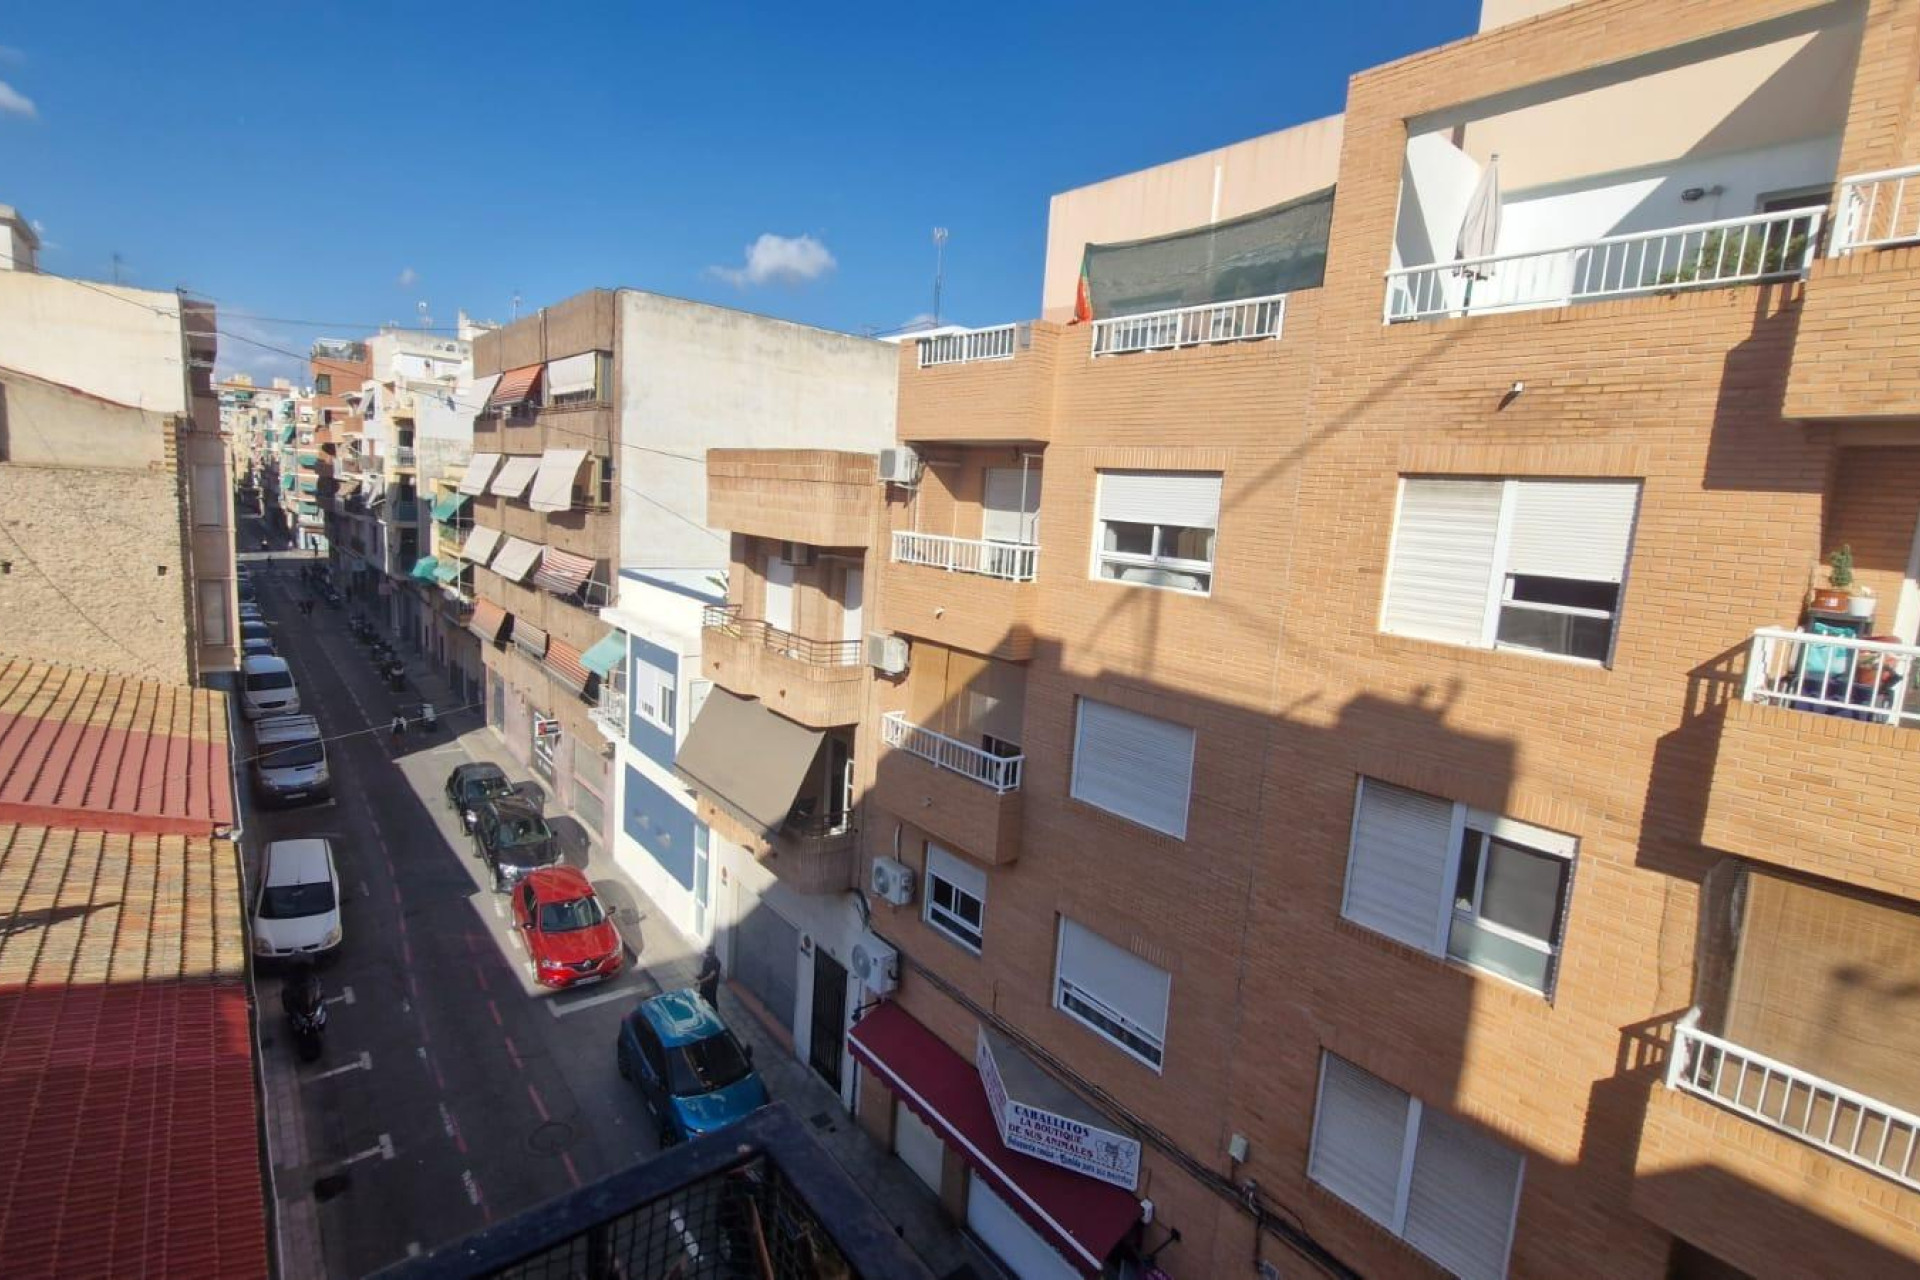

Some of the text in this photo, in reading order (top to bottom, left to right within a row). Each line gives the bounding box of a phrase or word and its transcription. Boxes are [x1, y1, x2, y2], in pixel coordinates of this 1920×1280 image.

[1014, 1105, 1089, 1136] CABALLITOS
[1019, 1116, 1083, 1144] LA BOUTIQUE
[1008, 1123, 1021, 1134] DE
[1044, 1135, 1093, 1157] ANIMALES
